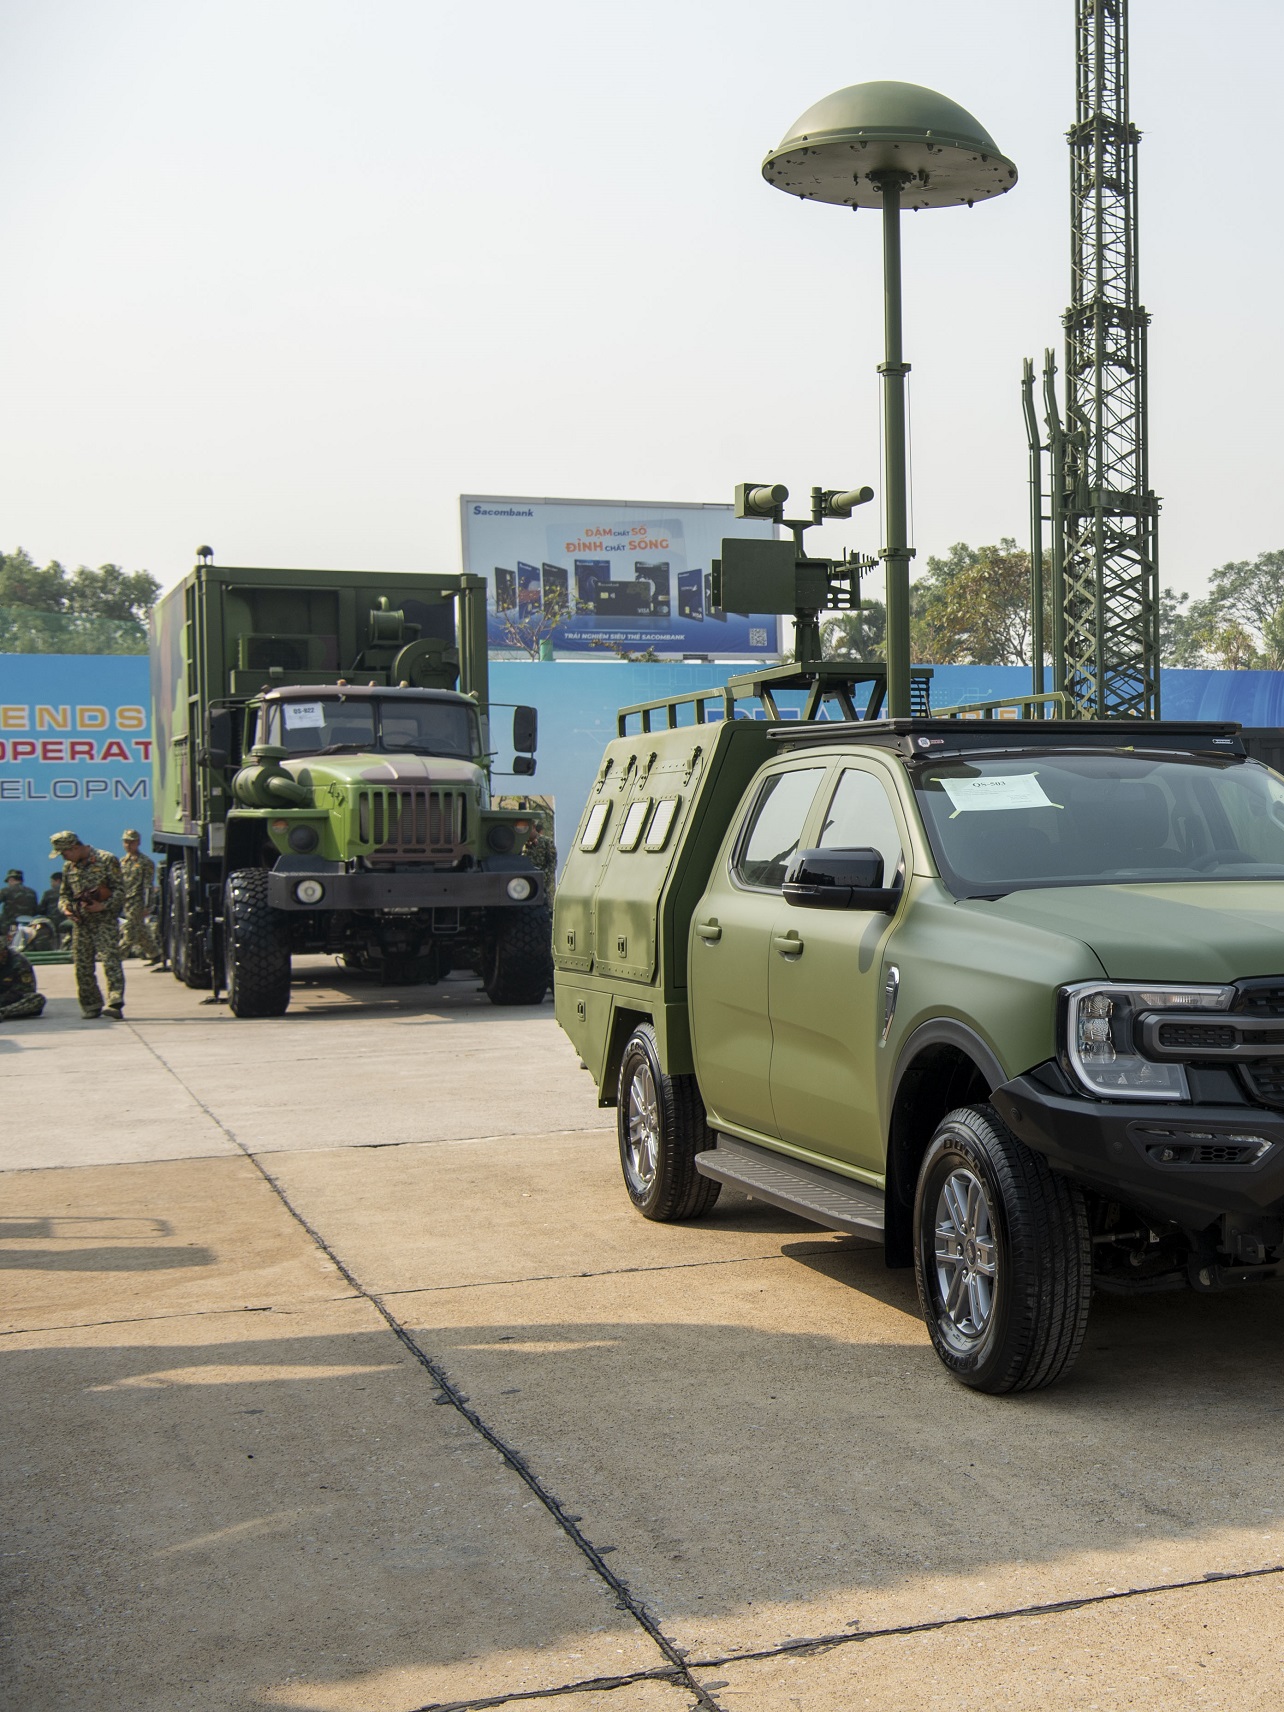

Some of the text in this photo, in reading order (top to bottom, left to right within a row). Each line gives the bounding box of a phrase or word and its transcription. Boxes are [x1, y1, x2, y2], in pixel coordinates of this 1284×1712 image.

[473, 505, 534, 517] Sacombank
[0, 704, 147, 731] ENDS
[0, 778, 149, 800] ELOPM
